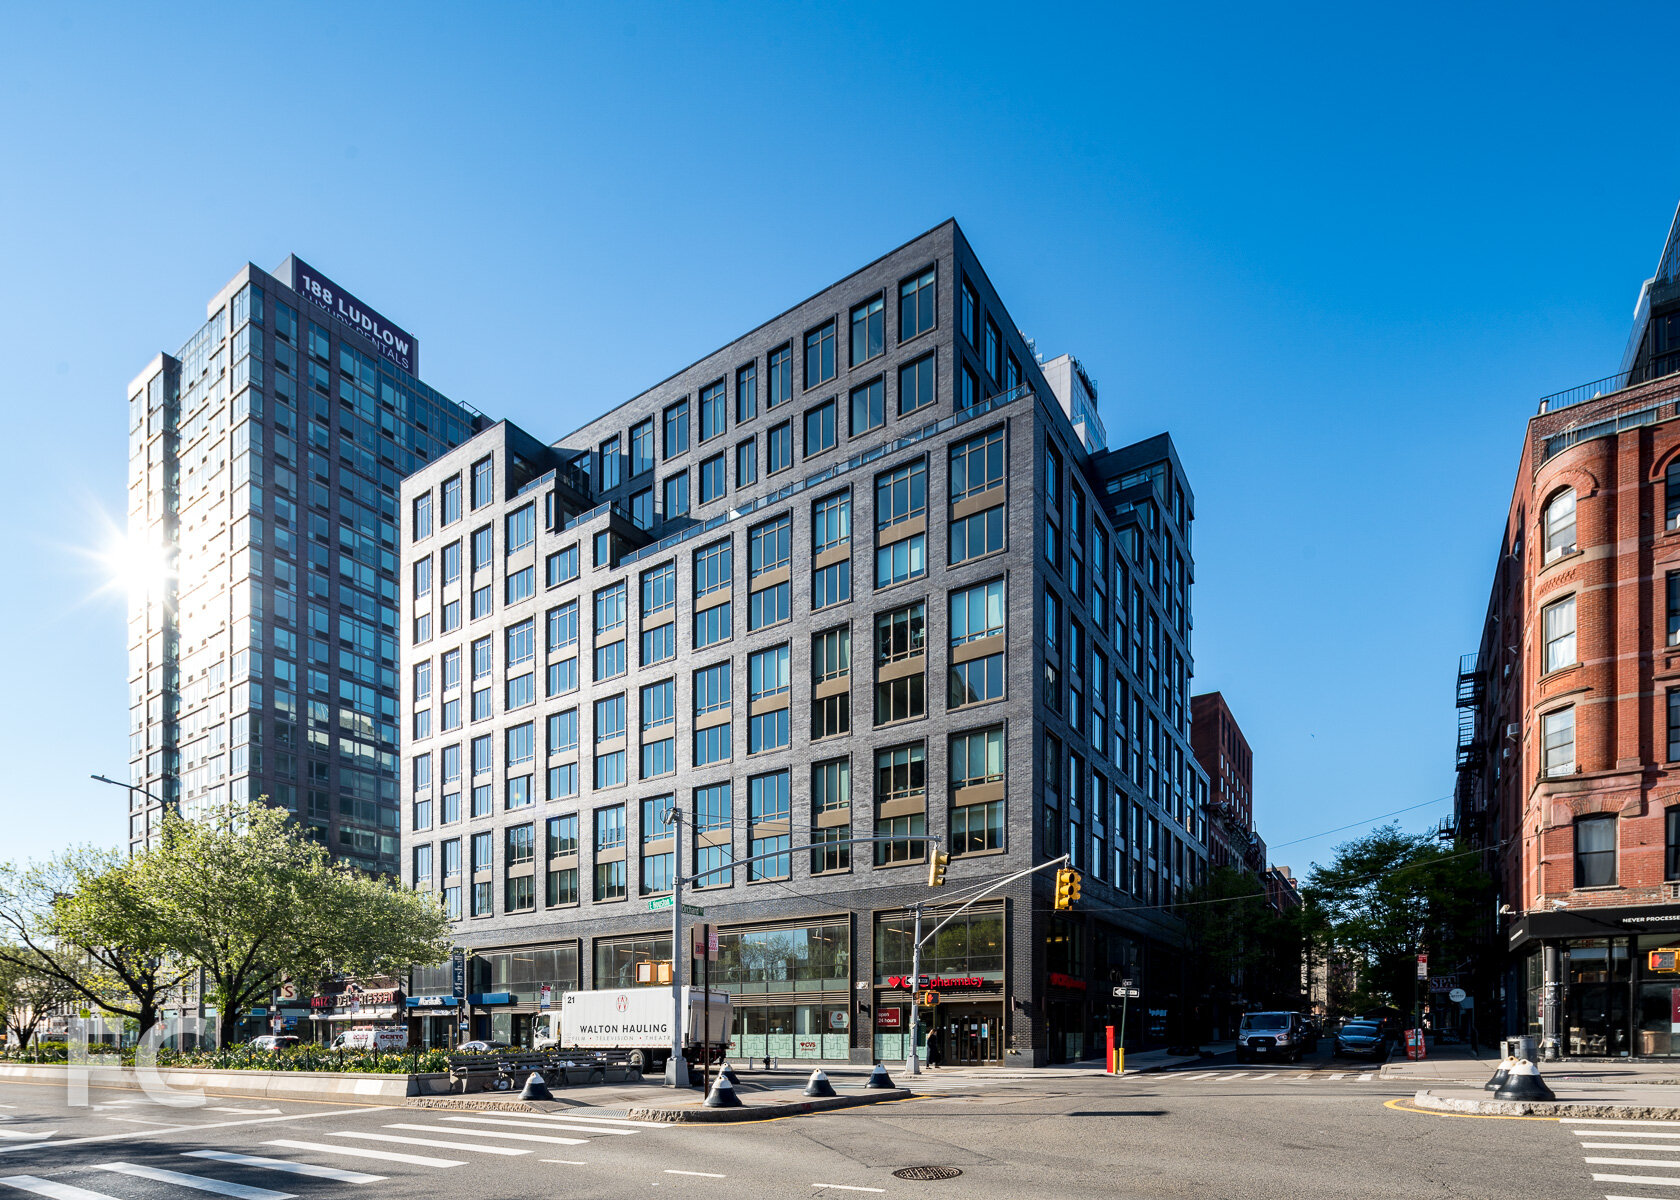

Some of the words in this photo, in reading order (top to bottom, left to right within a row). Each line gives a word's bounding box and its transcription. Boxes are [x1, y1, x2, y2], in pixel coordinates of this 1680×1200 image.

[302, 275, 333, 305] 188
[338, 297, 409, 356] LUDLOW
[930, 976, 984, 989] pharmacy
[336, 992, 394, 1007] DELATESSEN
[567, 996, 575, 1004] 21
[579, 1024, 619, 1034] WALTON
[622, 1023, 668, 1033] HAULING
